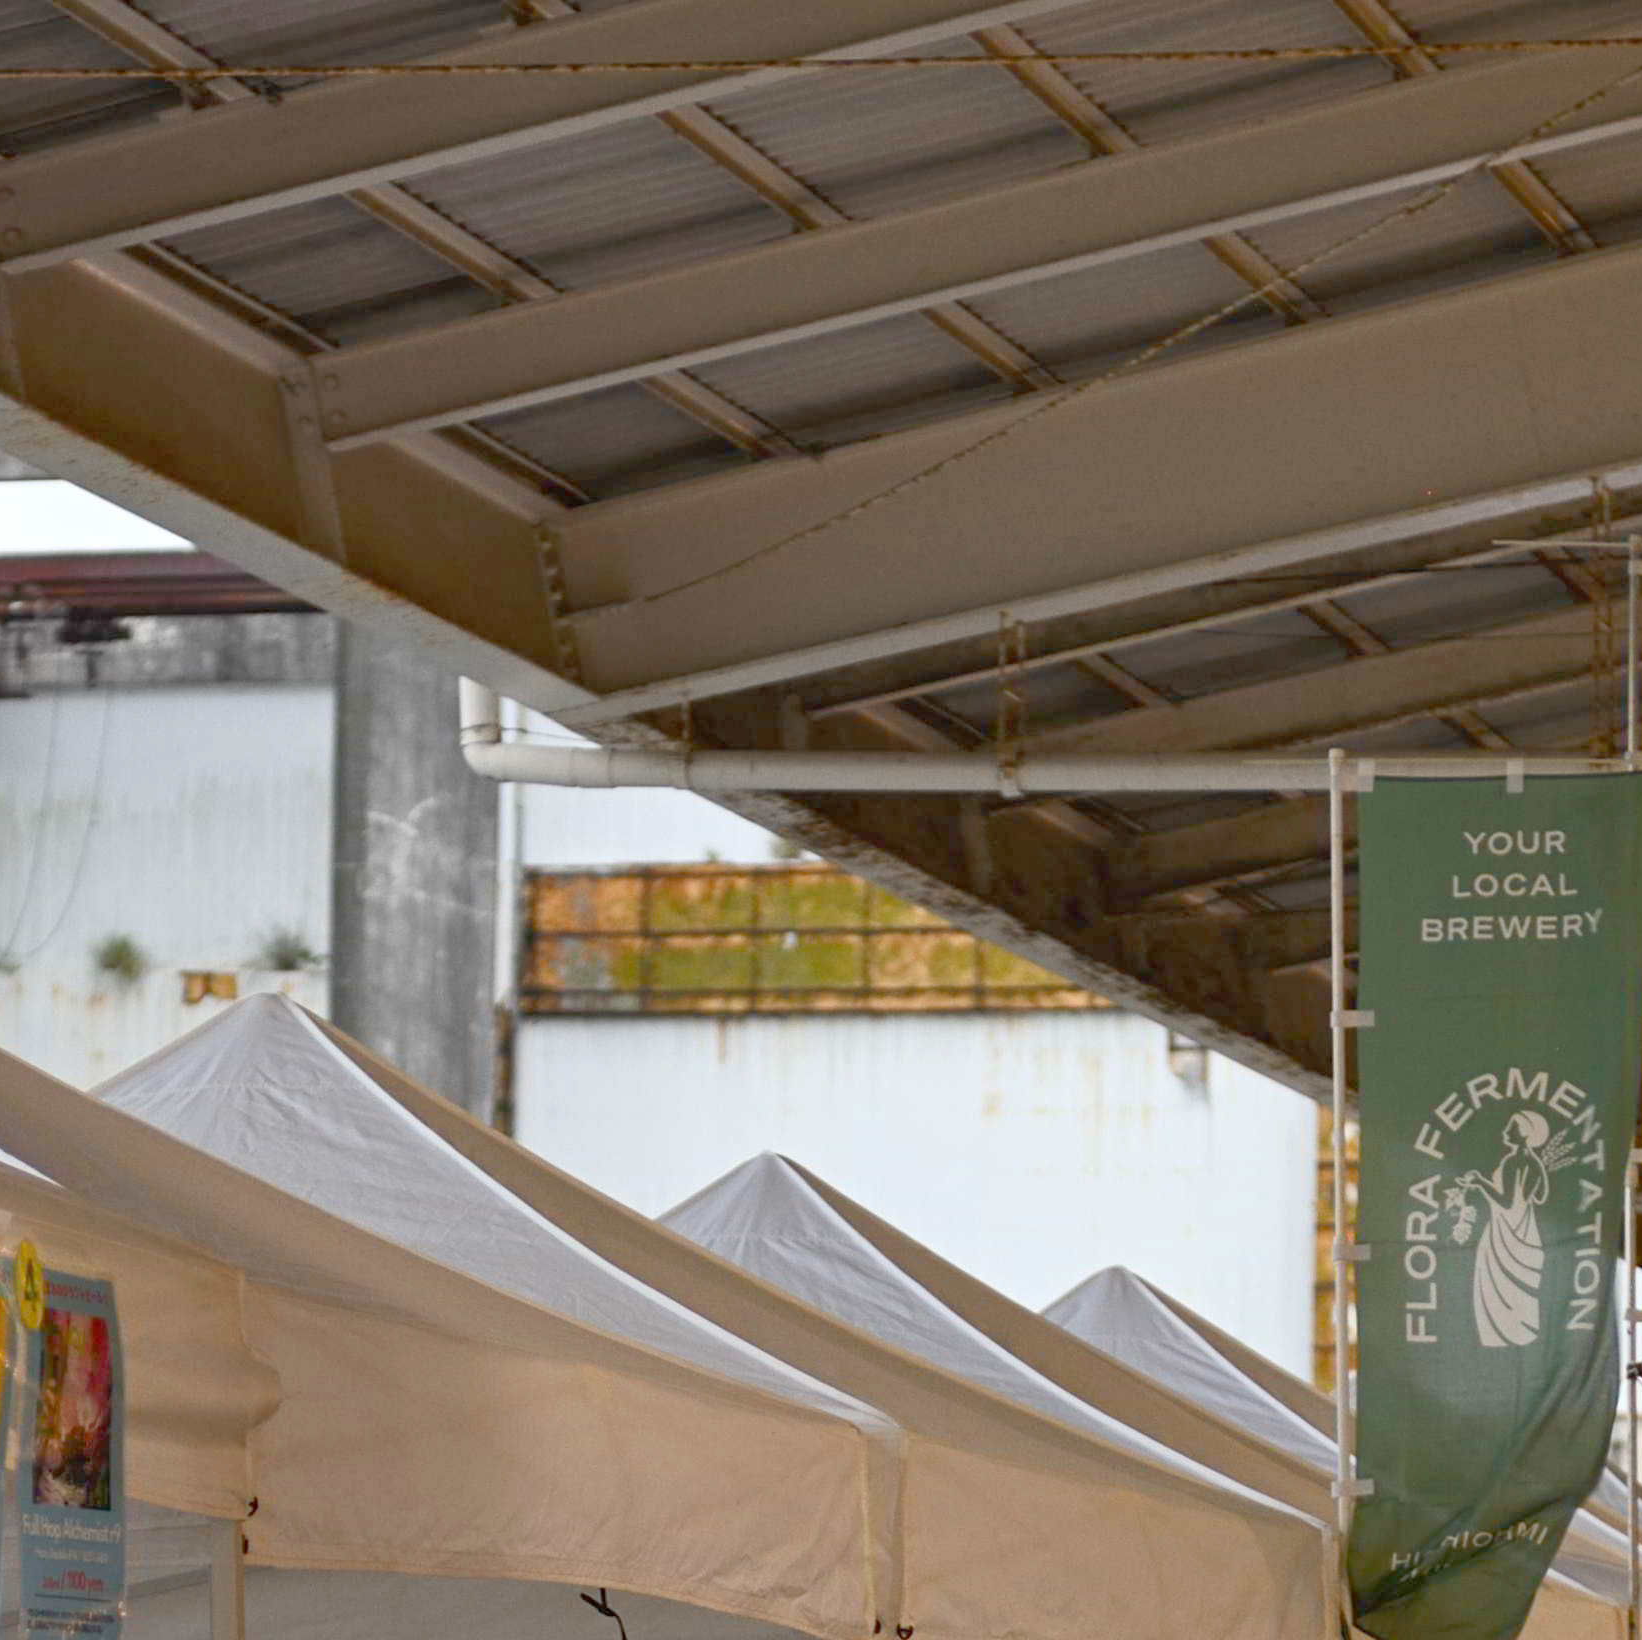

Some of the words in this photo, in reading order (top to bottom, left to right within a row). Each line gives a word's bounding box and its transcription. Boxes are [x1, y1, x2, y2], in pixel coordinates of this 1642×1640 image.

[1463, 830, 1567, 857] YOUR
[1451, 873, 1578, 898] LOCAL
[1421, 908, 1604, 944] BREWERY
[1415, 1066, 1605, 1332] FERMENTATION
[1405, 1175, 1443, 1345] FLORA
[23, 1257, 38, 1314] 4
